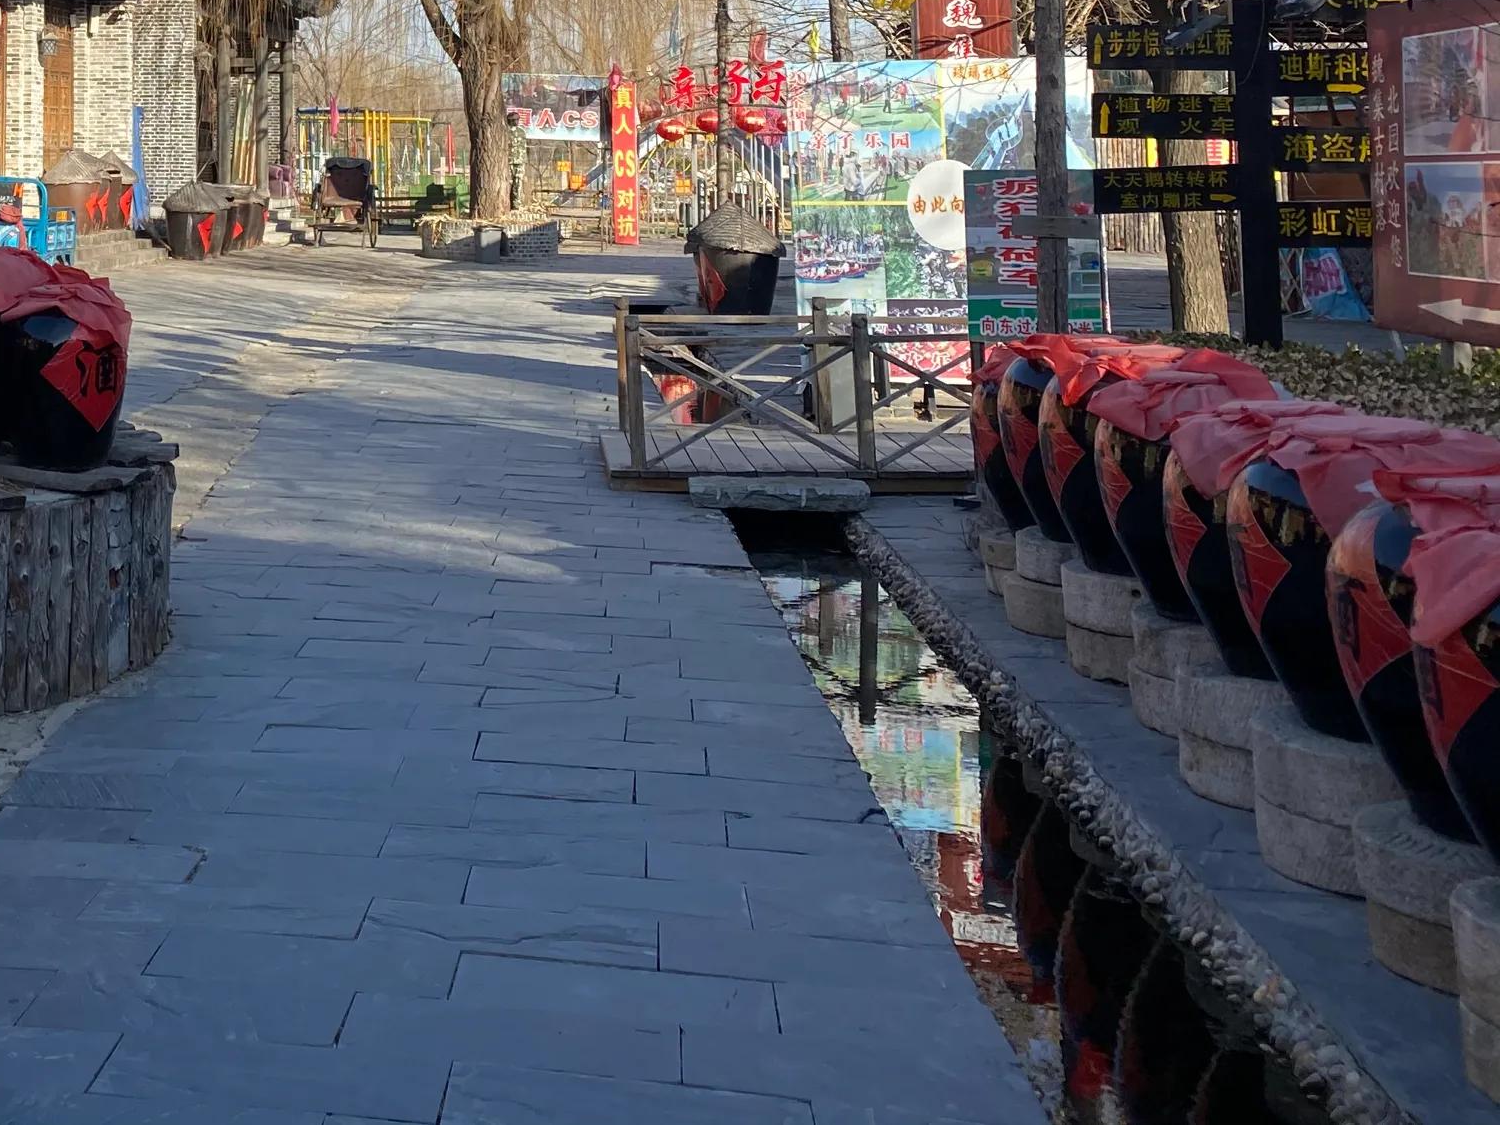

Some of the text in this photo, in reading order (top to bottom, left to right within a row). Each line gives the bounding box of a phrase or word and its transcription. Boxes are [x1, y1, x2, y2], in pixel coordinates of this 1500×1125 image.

[1116, 97, 1234, 113] 植物迷宫
[76, 340, 121, 397] 酒
